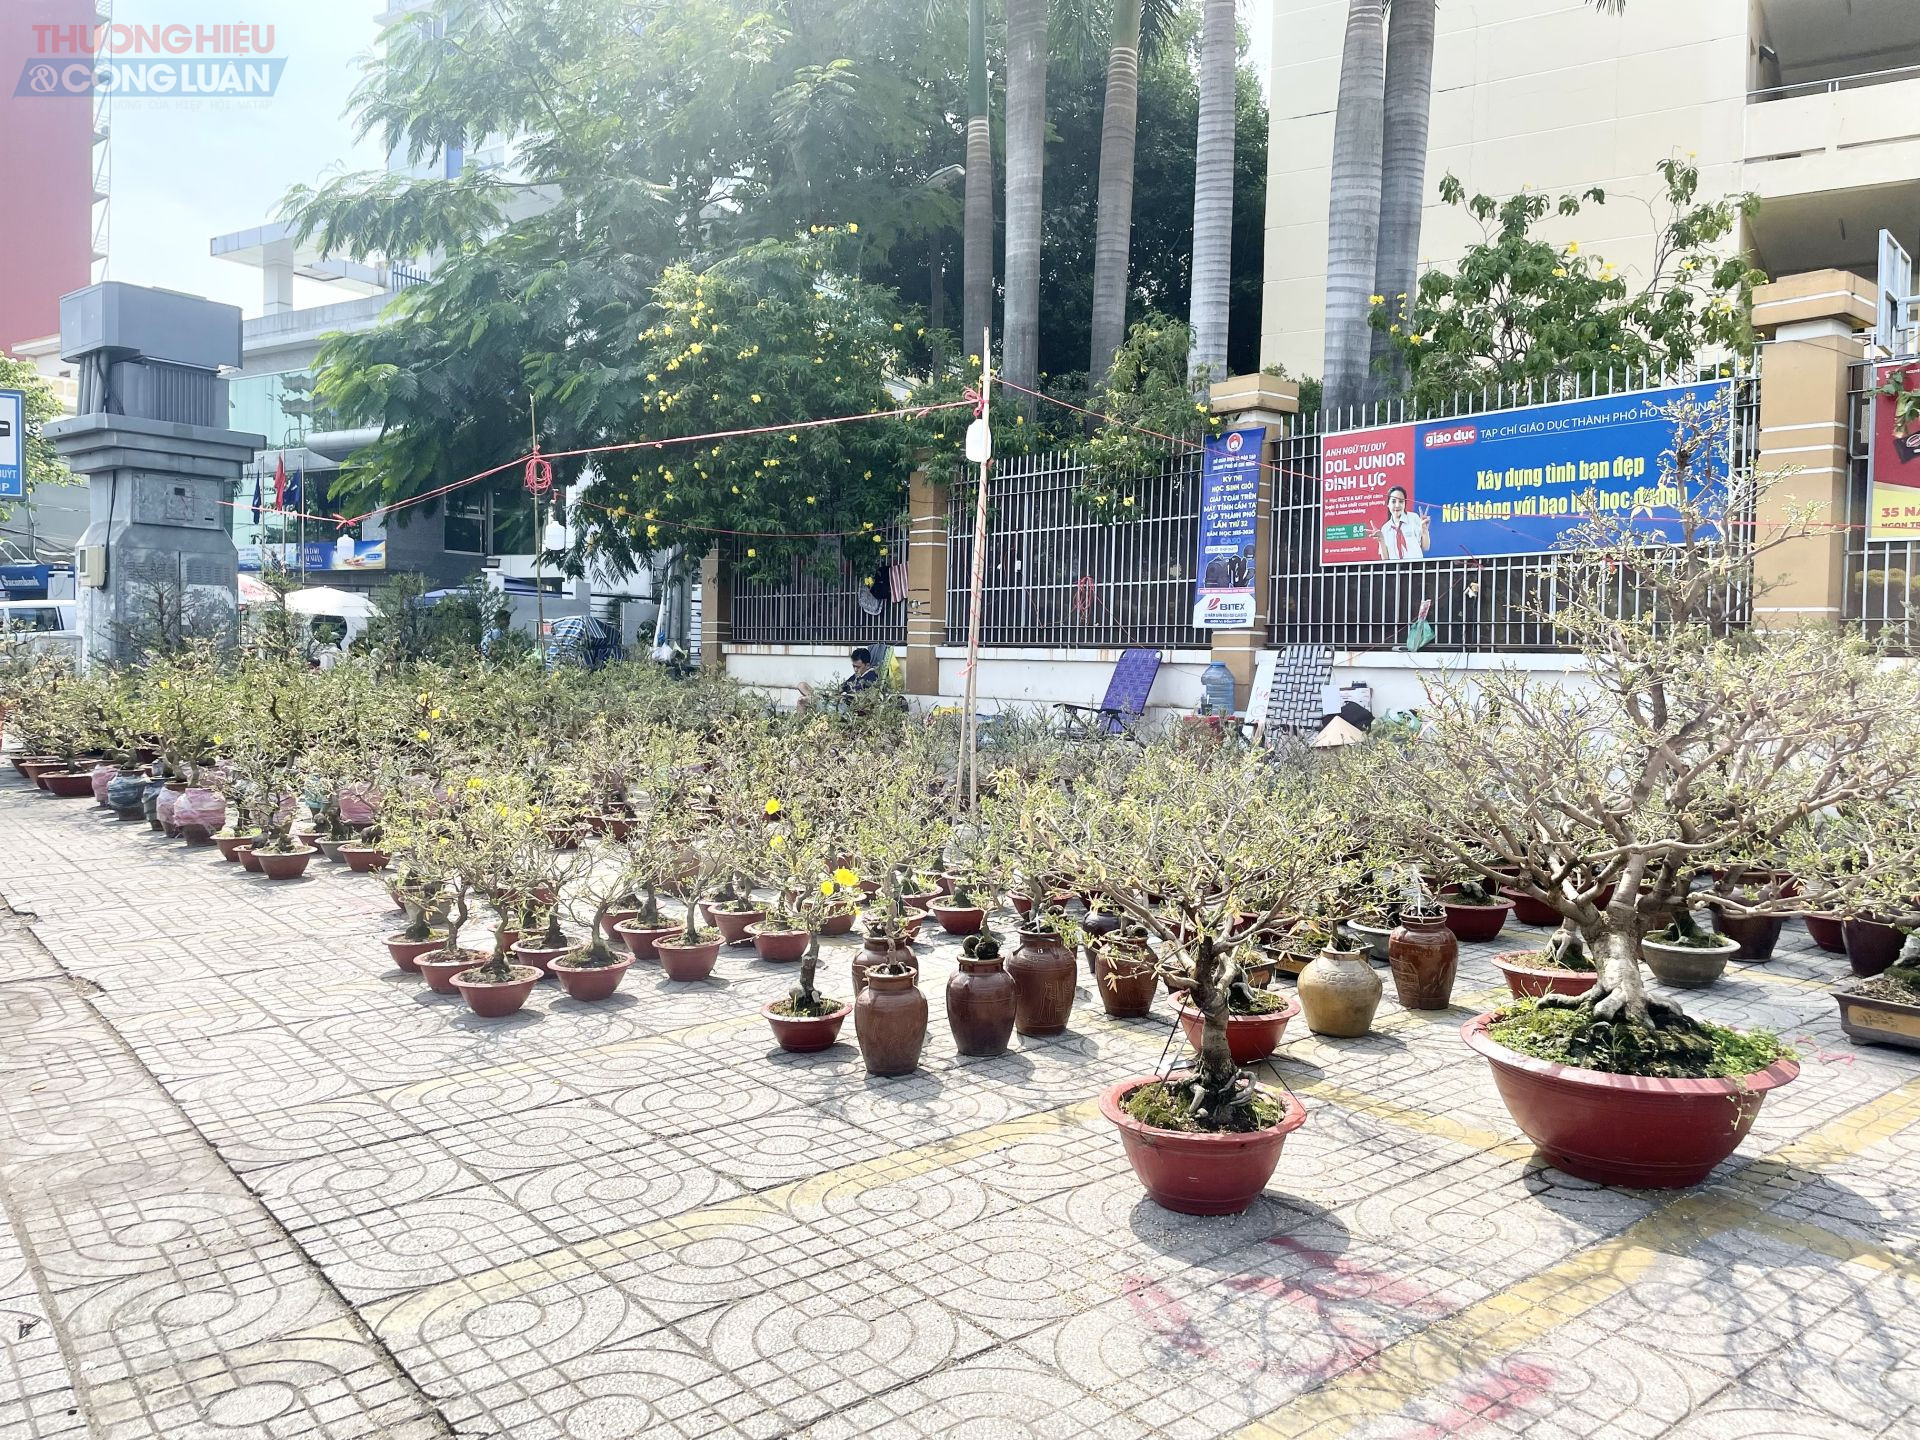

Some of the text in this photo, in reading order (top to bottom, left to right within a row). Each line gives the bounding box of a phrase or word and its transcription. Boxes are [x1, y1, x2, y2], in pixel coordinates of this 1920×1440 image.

[1480, 429, 1496, 440] TẠP
[1500, 424, 1518, 436] CHÍ
[1519, 420, 1544, 434] GIÁO
[1546, 418, 1570, 432] DỤC
[1571, 413, 1610, 428] THÀNH
[1613, 407, 1638, 422] PHỐ
[1426, 430, 1474, 446] giáo dục
[1326, 448, 1342, 457] ANH
[1370, 442, 1387, 452] DUY
[0, 467, 16, 479] UÝT
[1325, 452, 1406, 474] DOL JUNIOR
[1477, 456, 1645, 491] Xây dụng tình bạn đẹp
[1325, 471, 1387, 492] ĐÌNH LỰC
[1442, 503, 1464, 523] Nói
[1467, 500, 1511, 521] không
[1514, 496, 1537, 516] với
[1540, 496, 1566, 516] bạo
[1600, 490, 1631, 516] học
[1882, 507, 1900, 517] 35
